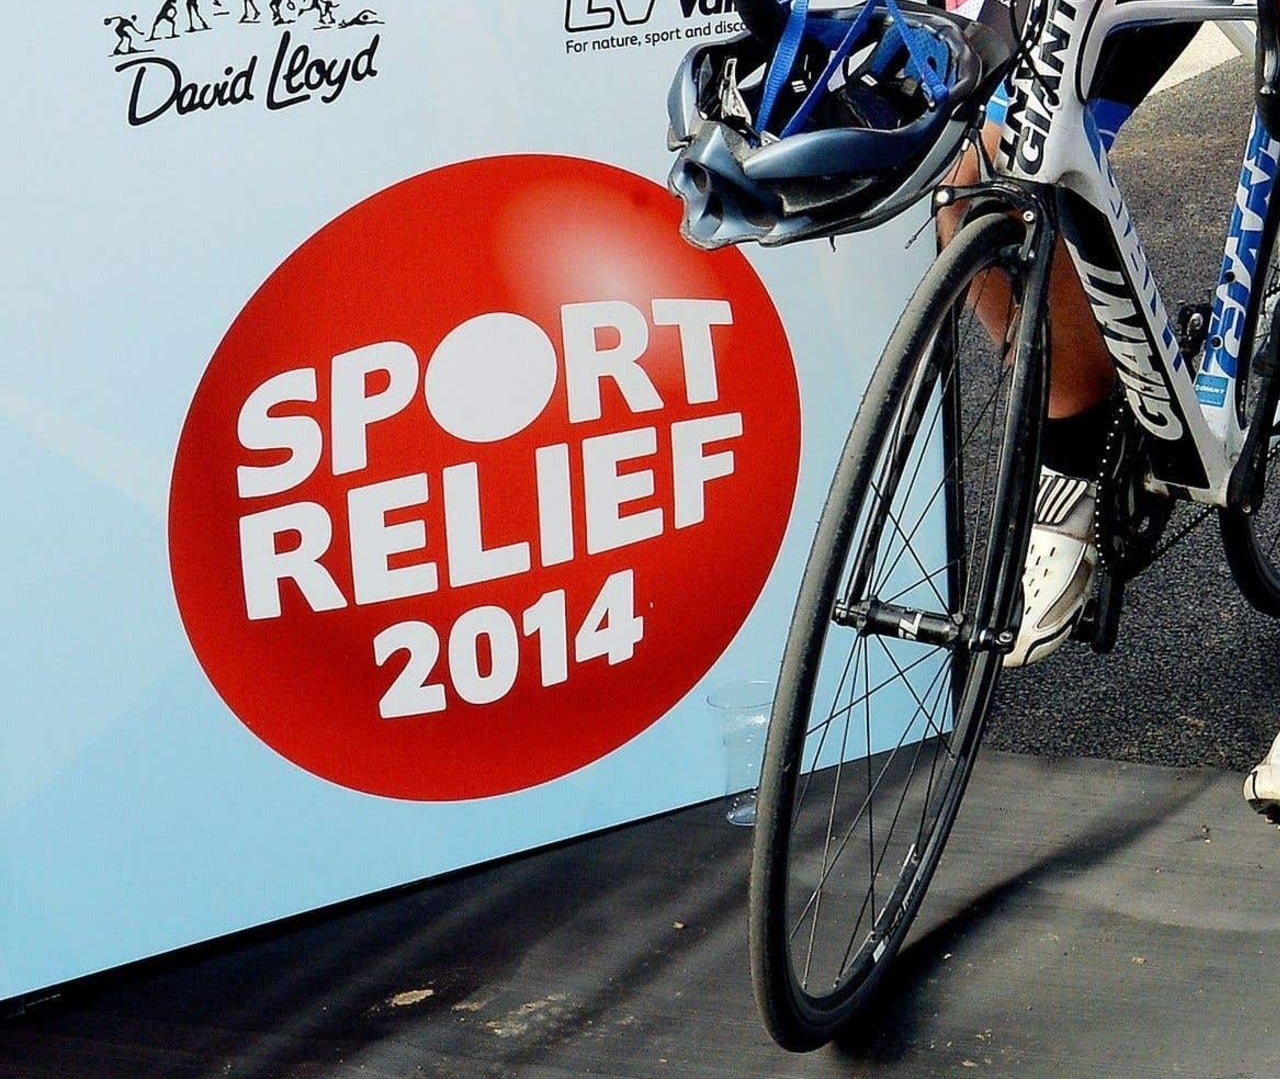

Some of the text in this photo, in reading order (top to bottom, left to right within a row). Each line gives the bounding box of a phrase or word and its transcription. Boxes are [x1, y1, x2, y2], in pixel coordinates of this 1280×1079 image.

[115, 31, 377, 126] David Lloyd
[566, 40, 588, 54] For
[592, 32, 642, 50] nature,
[645, 27, 682, 46] sport
[686, 22, 711, 38] and
[236, 298, 733, 500] SPORT
[1065, 238, 1183, 441] GIANT
[238, 412, 744, 621] RELIEF
[372, 570, 645, 720] 2014
